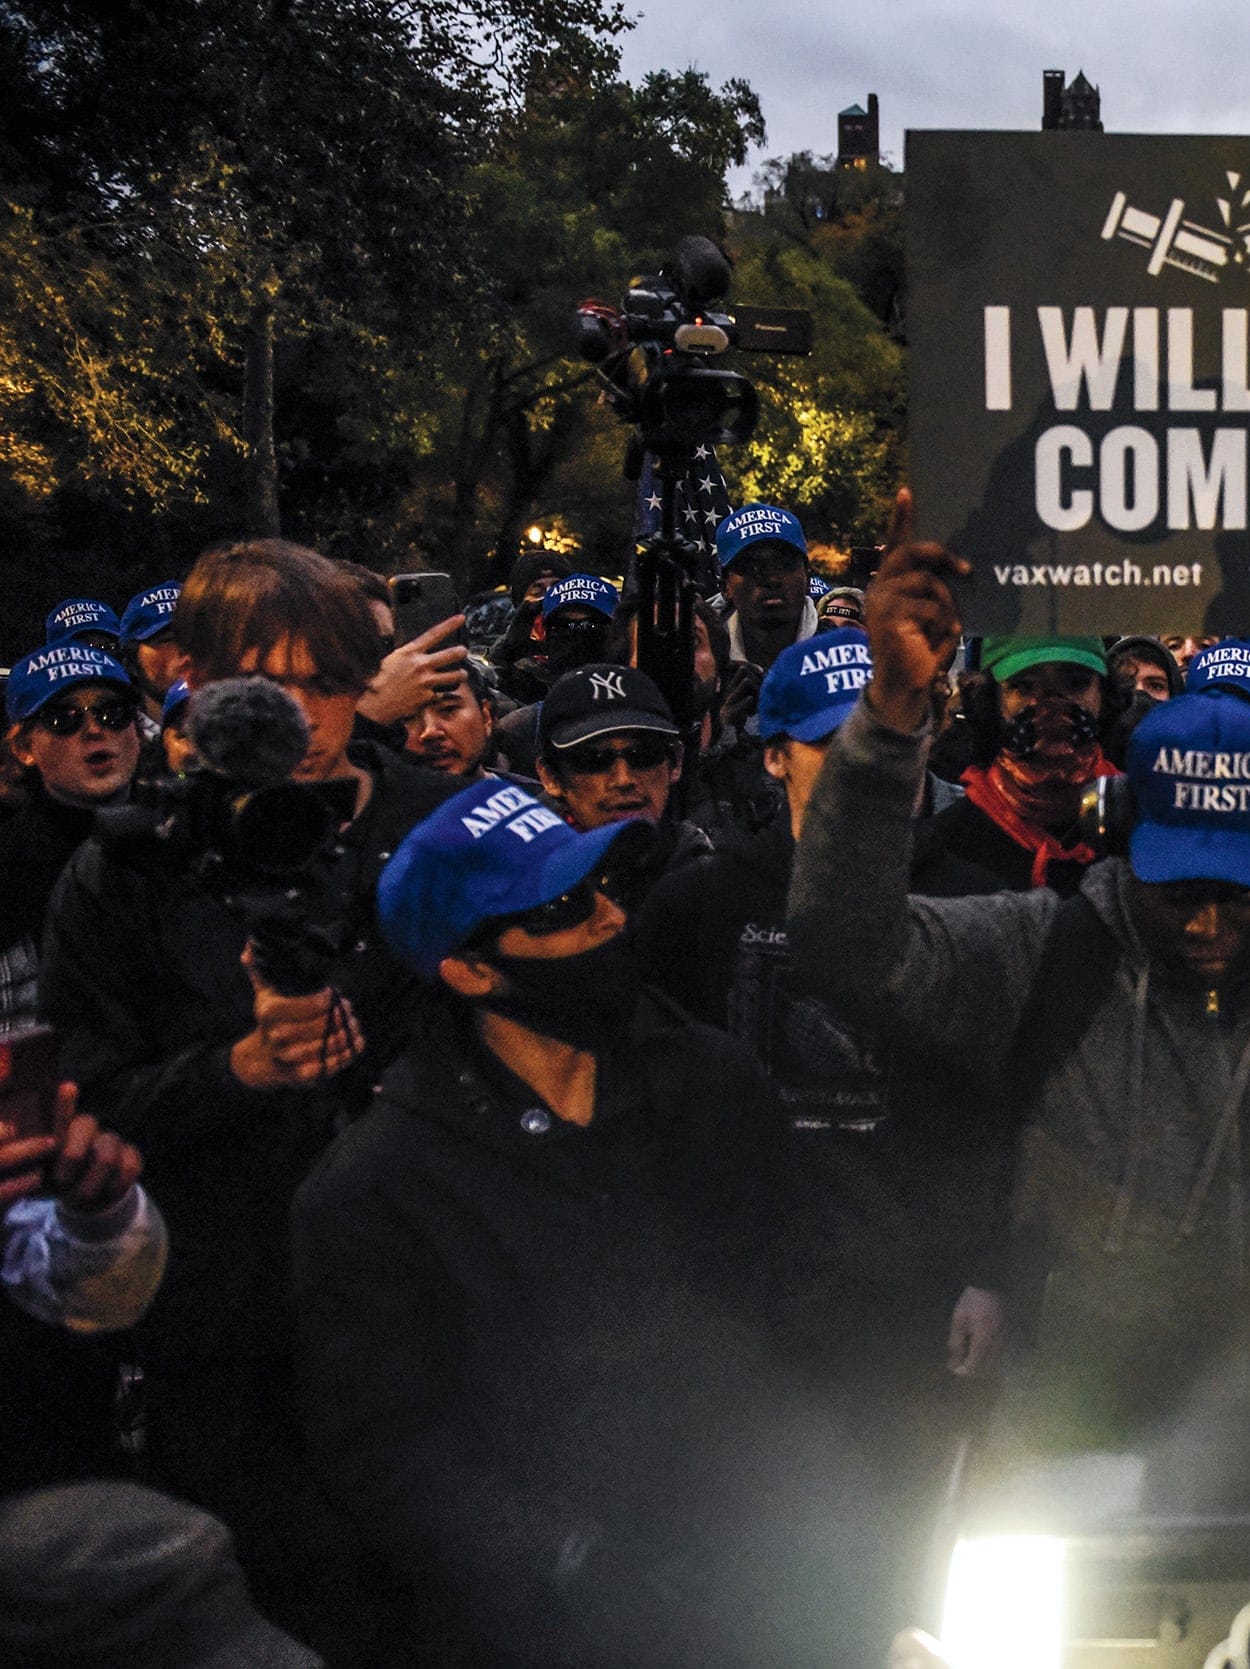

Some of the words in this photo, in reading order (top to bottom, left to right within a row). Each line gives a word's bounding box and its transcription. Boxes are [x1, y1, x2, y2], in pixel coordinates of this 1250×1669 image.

[984, 305, 1012, 411] I
[725, 509, 793, 533] AMERICA
[740, 522, 782, 540] FIRST
[994, 559, 1202, 586] vaxwatch.net
[550, 578, 609, 597] AMERICA
[560, 589, 598, 603] FIRST
[54, 602, 107, 624] AMERICA
[64, 612, 100, 628] FIRST
[26, 647, 116, 675] AMERICA
[800, 644, 874, 676] AMER
[47, 663, 104, 682] FIRST
[588, 671, 627, 700] NY
[460, 786, 539, 839] AMER
[740, 922, 790, 944] Scie
